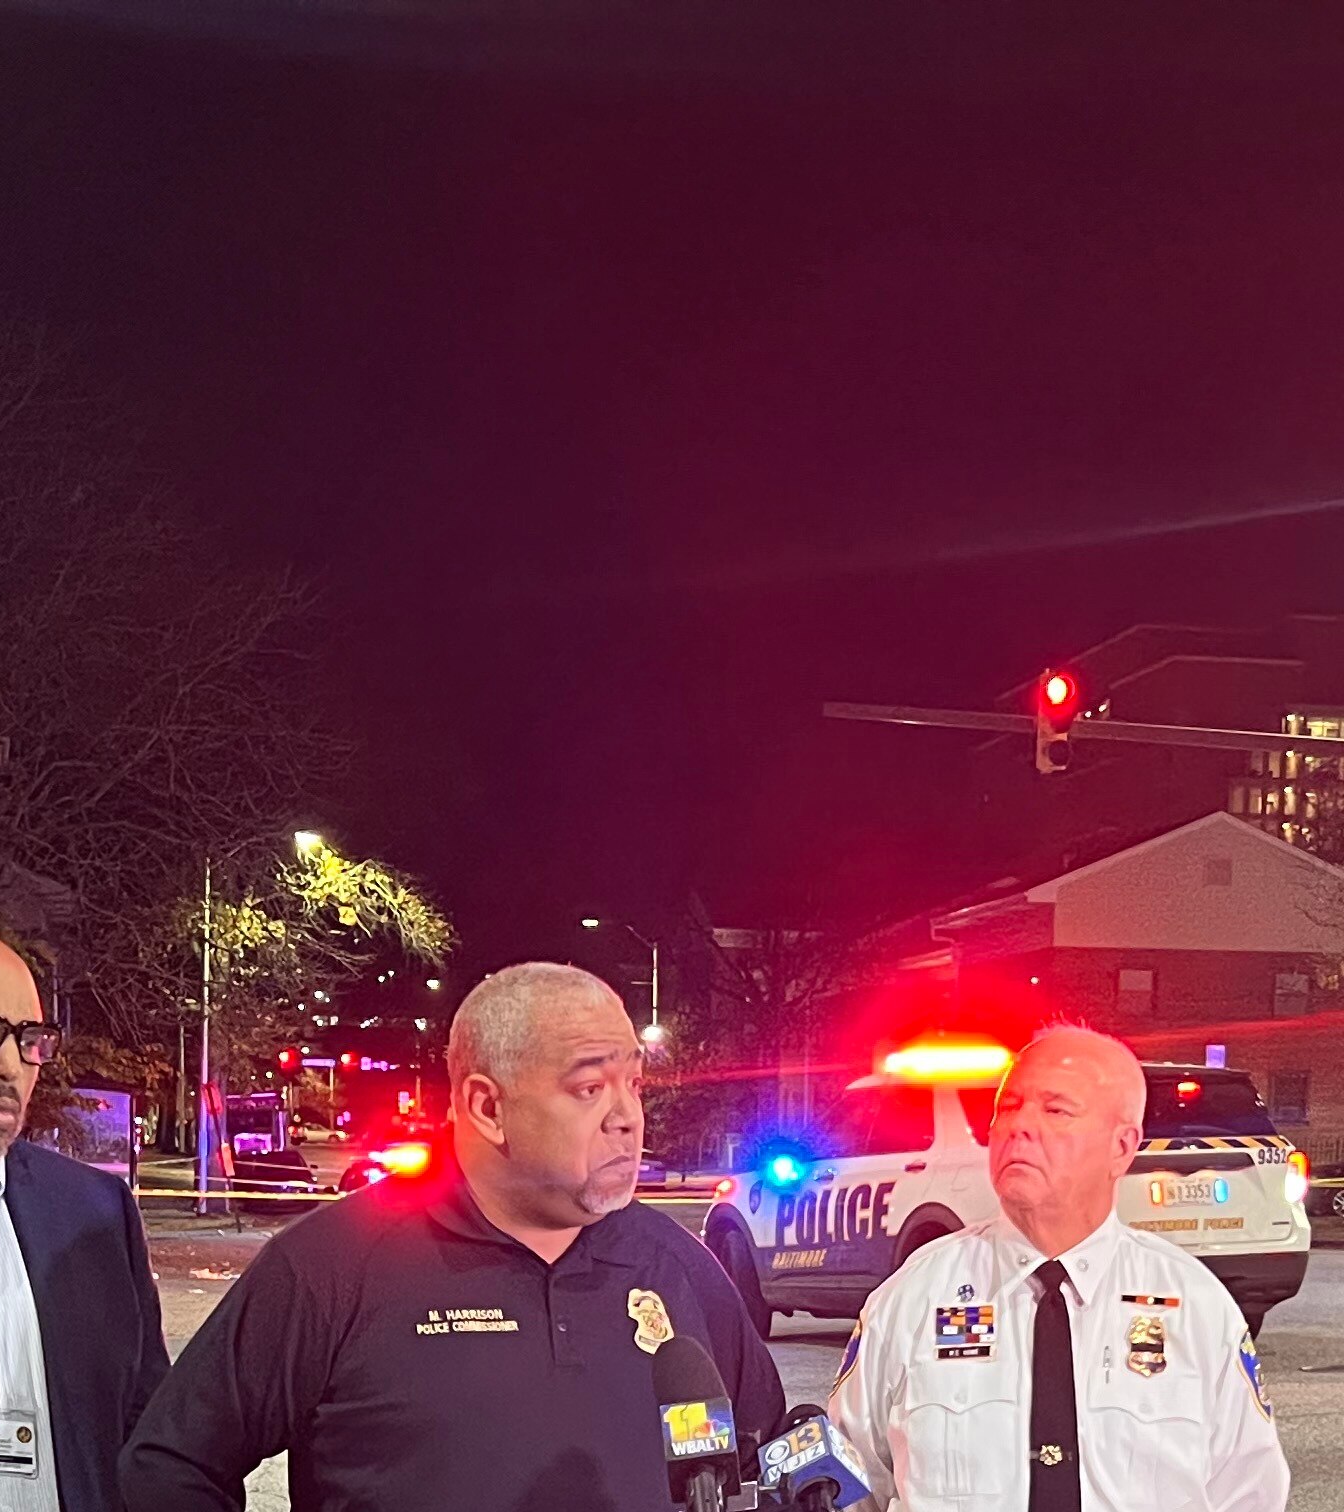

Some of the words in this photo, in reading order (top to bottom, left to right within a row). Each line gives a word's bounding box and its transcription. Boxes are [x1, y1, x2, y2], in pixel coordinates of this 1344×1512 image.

[775, 1182, 897, 1247] POLICE
[772, 1249, 827, 1270] BALTIMORE
[416, 1322, 450, 1335] POLICE
[452, 1320, 519, 1332] COMMISSIONER
[445, 1308, 504, 1320] HARRISON
[786, 1422, 822, 1455] 13
[767, 1442, 824, 1480] WJZ
